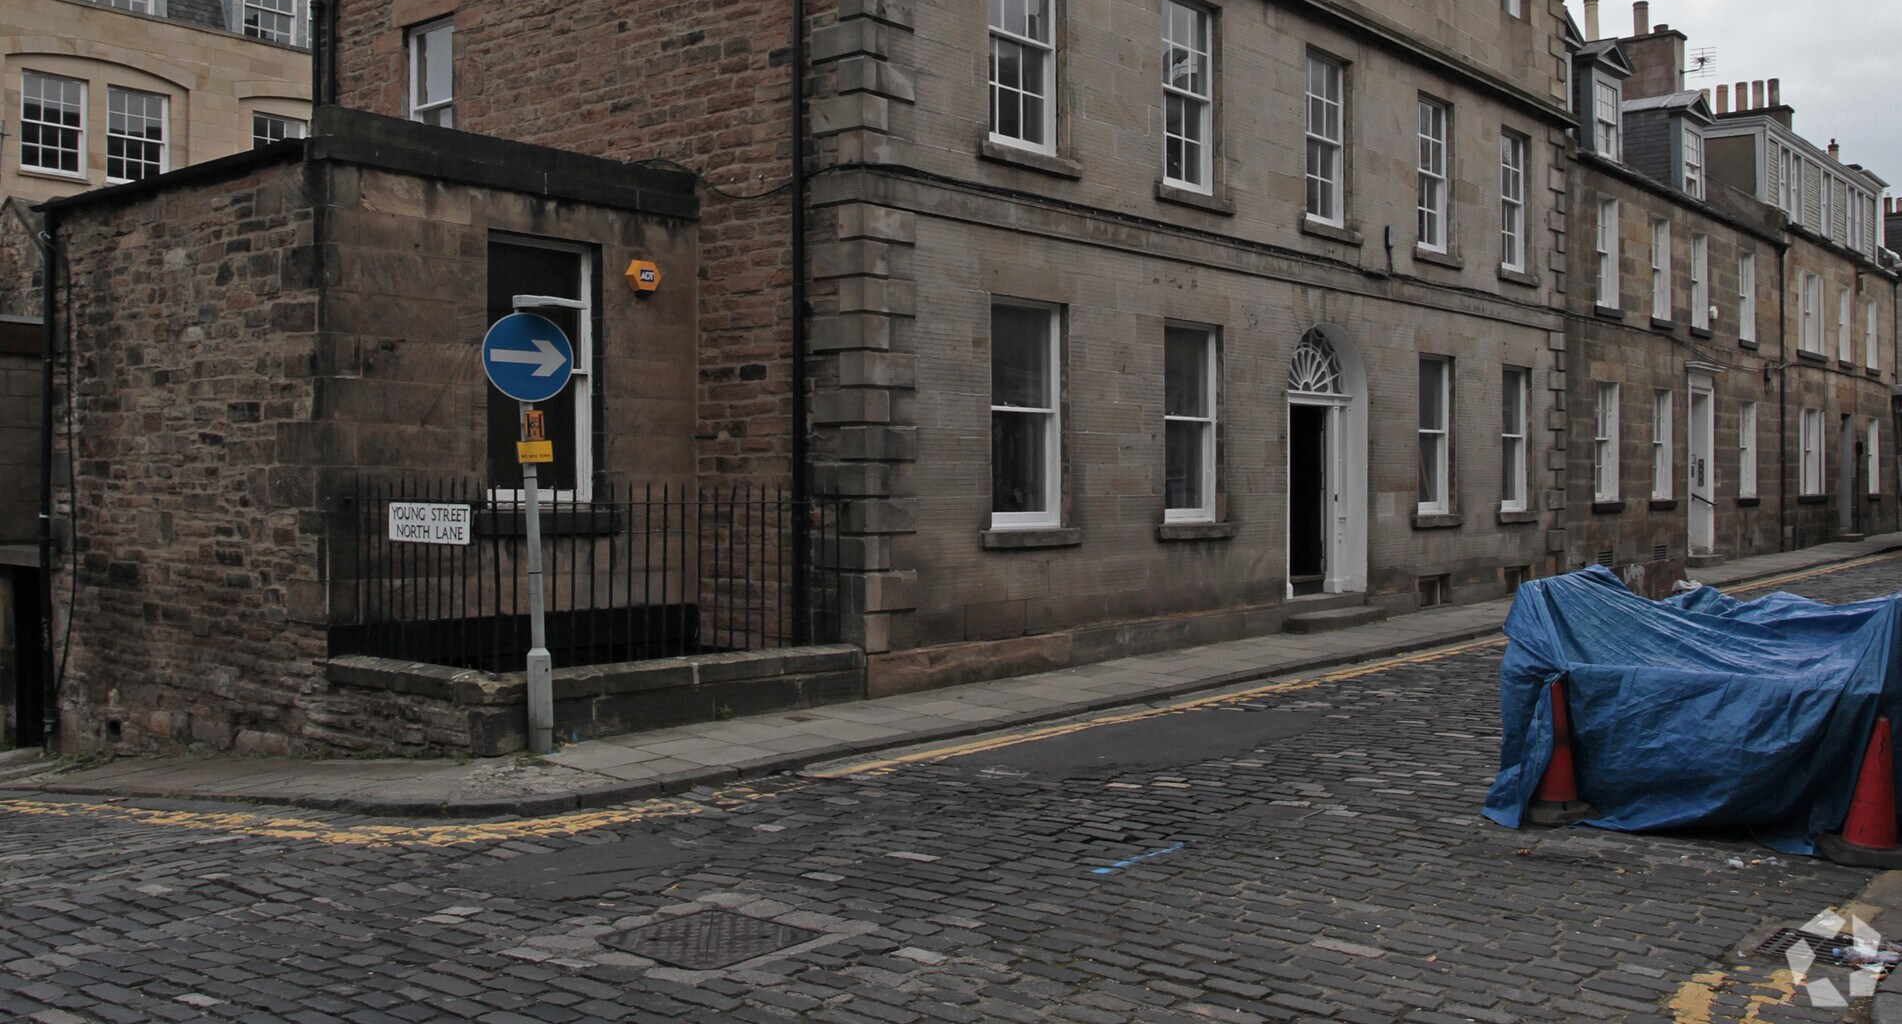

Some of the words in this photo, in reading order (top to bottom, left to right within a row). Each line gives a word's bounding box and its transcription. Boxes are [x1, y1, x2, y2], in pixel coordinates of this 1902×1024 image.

[640, 271, 654, 281] ADT
[391, 506, 426, 521] YOUNG
[431, 507, 468, 523] STREET
[396, 524, 430, 539] NORTH
[436, 526, 463, 541] LANE
